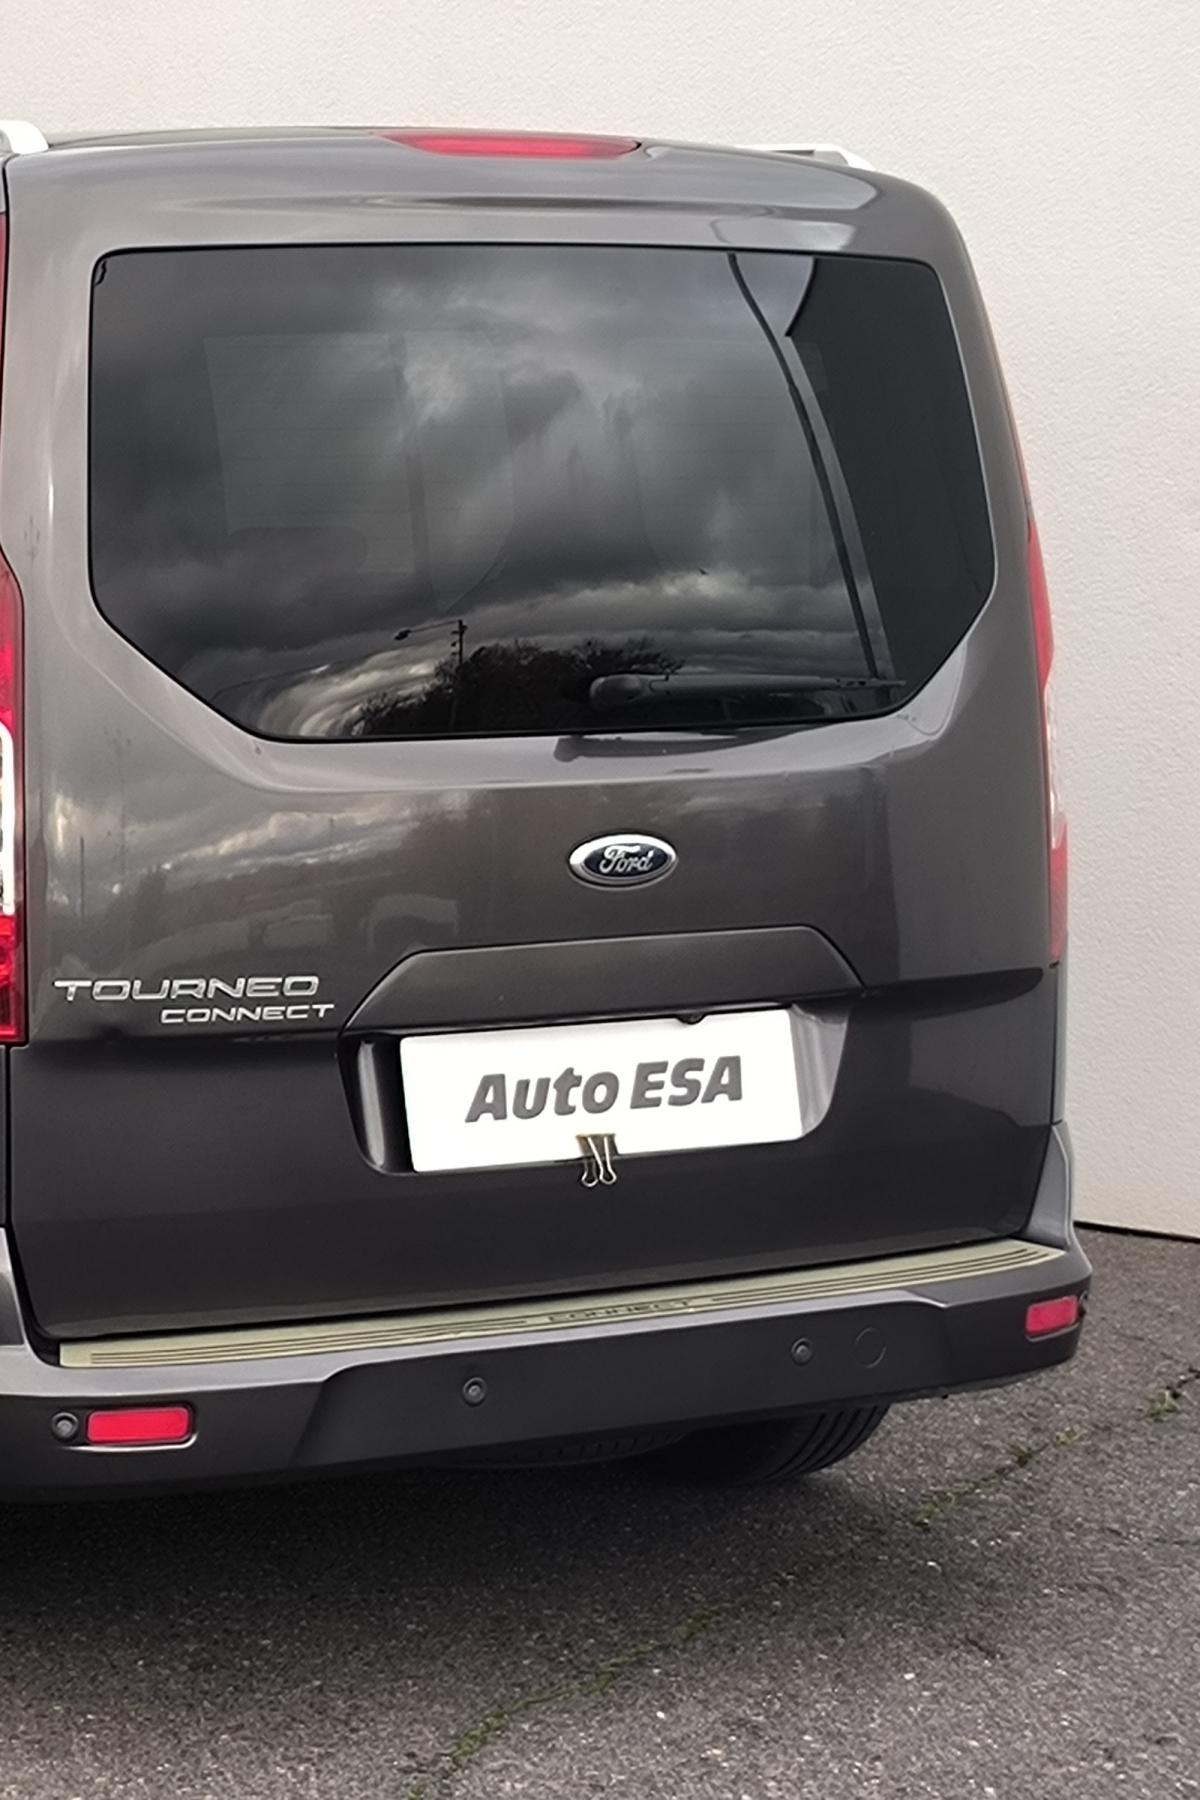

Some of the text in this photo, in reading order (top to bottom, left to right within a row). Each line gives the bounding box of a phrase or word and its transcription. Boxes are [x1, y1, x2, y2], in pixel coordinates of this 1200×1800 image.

[599, 844, 655, 874] Ford
[53, 974, 321, 1002] TOURNEO
[160, 1003, 335, 1024] CONNECT
[465, 1055, 744, 1123] Auto ESA
